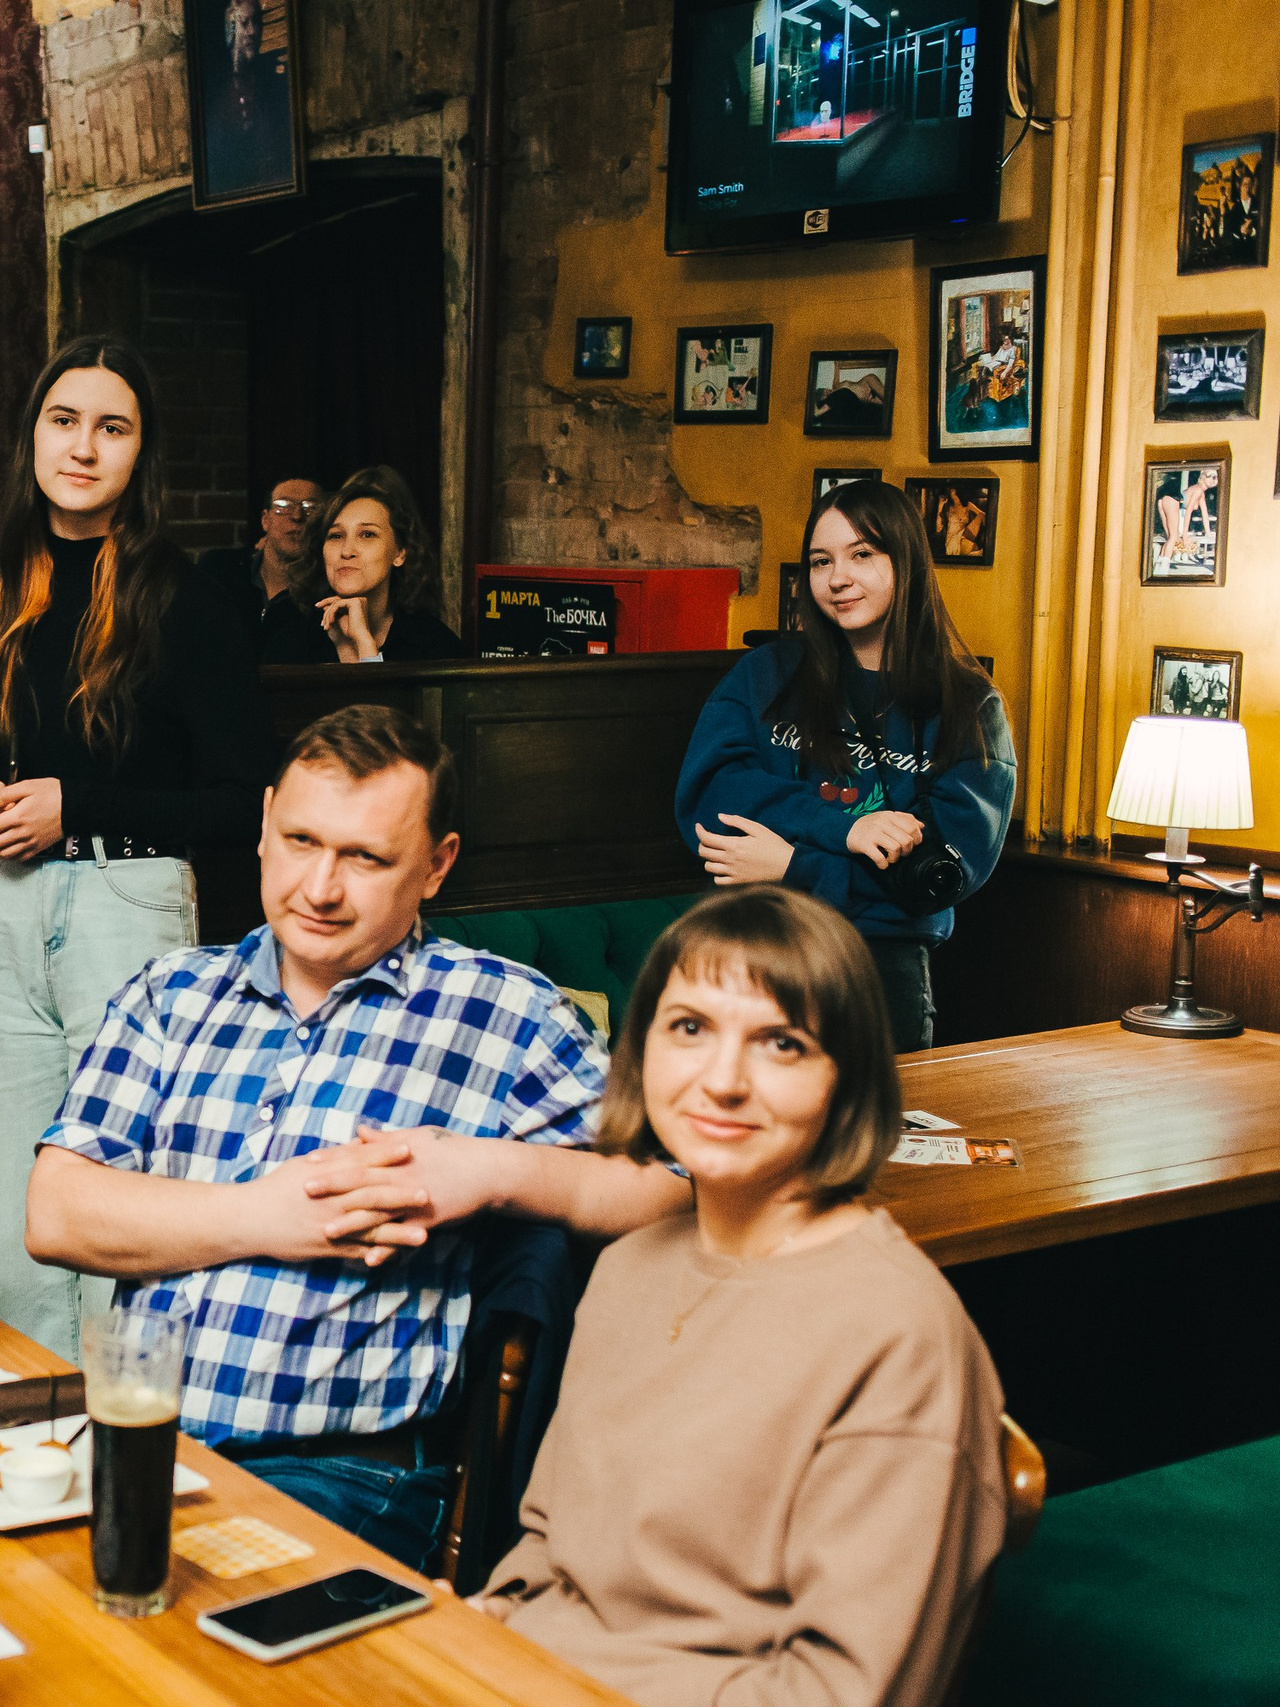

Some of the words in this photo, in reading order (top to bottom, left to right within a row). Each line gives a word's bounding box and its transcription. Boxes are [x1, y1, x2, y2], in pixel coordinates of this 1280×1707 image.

[698, 187, 717, 197] Sam
[718, 182, 744, 195] Smith
[485, 590, 501, 619] 1
[500, 590, 541, 607] МАРТА
